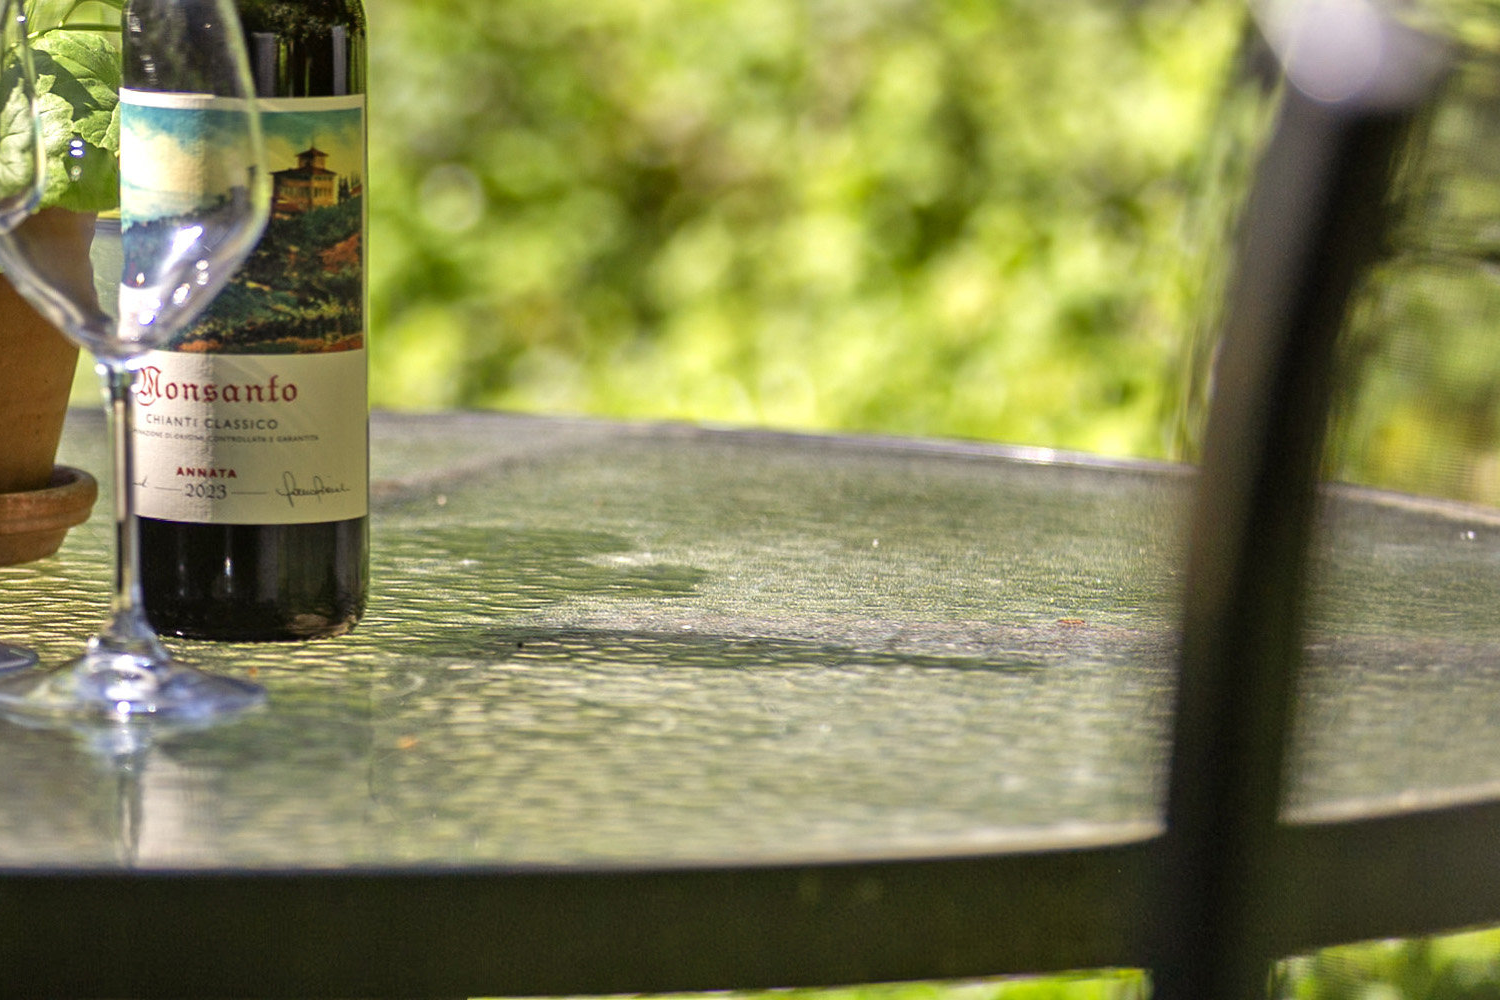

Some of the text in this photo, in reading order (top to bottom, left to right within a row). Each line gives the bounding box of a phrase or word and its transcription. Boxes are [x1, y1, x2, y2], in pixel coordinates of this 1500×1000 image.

[137, 365, 298, 407] Monsanto
[146, 413, 279, 431] CHIANTI CLASSICO
[176, 466, 237, 479] ANNATA
[185, 483, 227, 499] 2023
